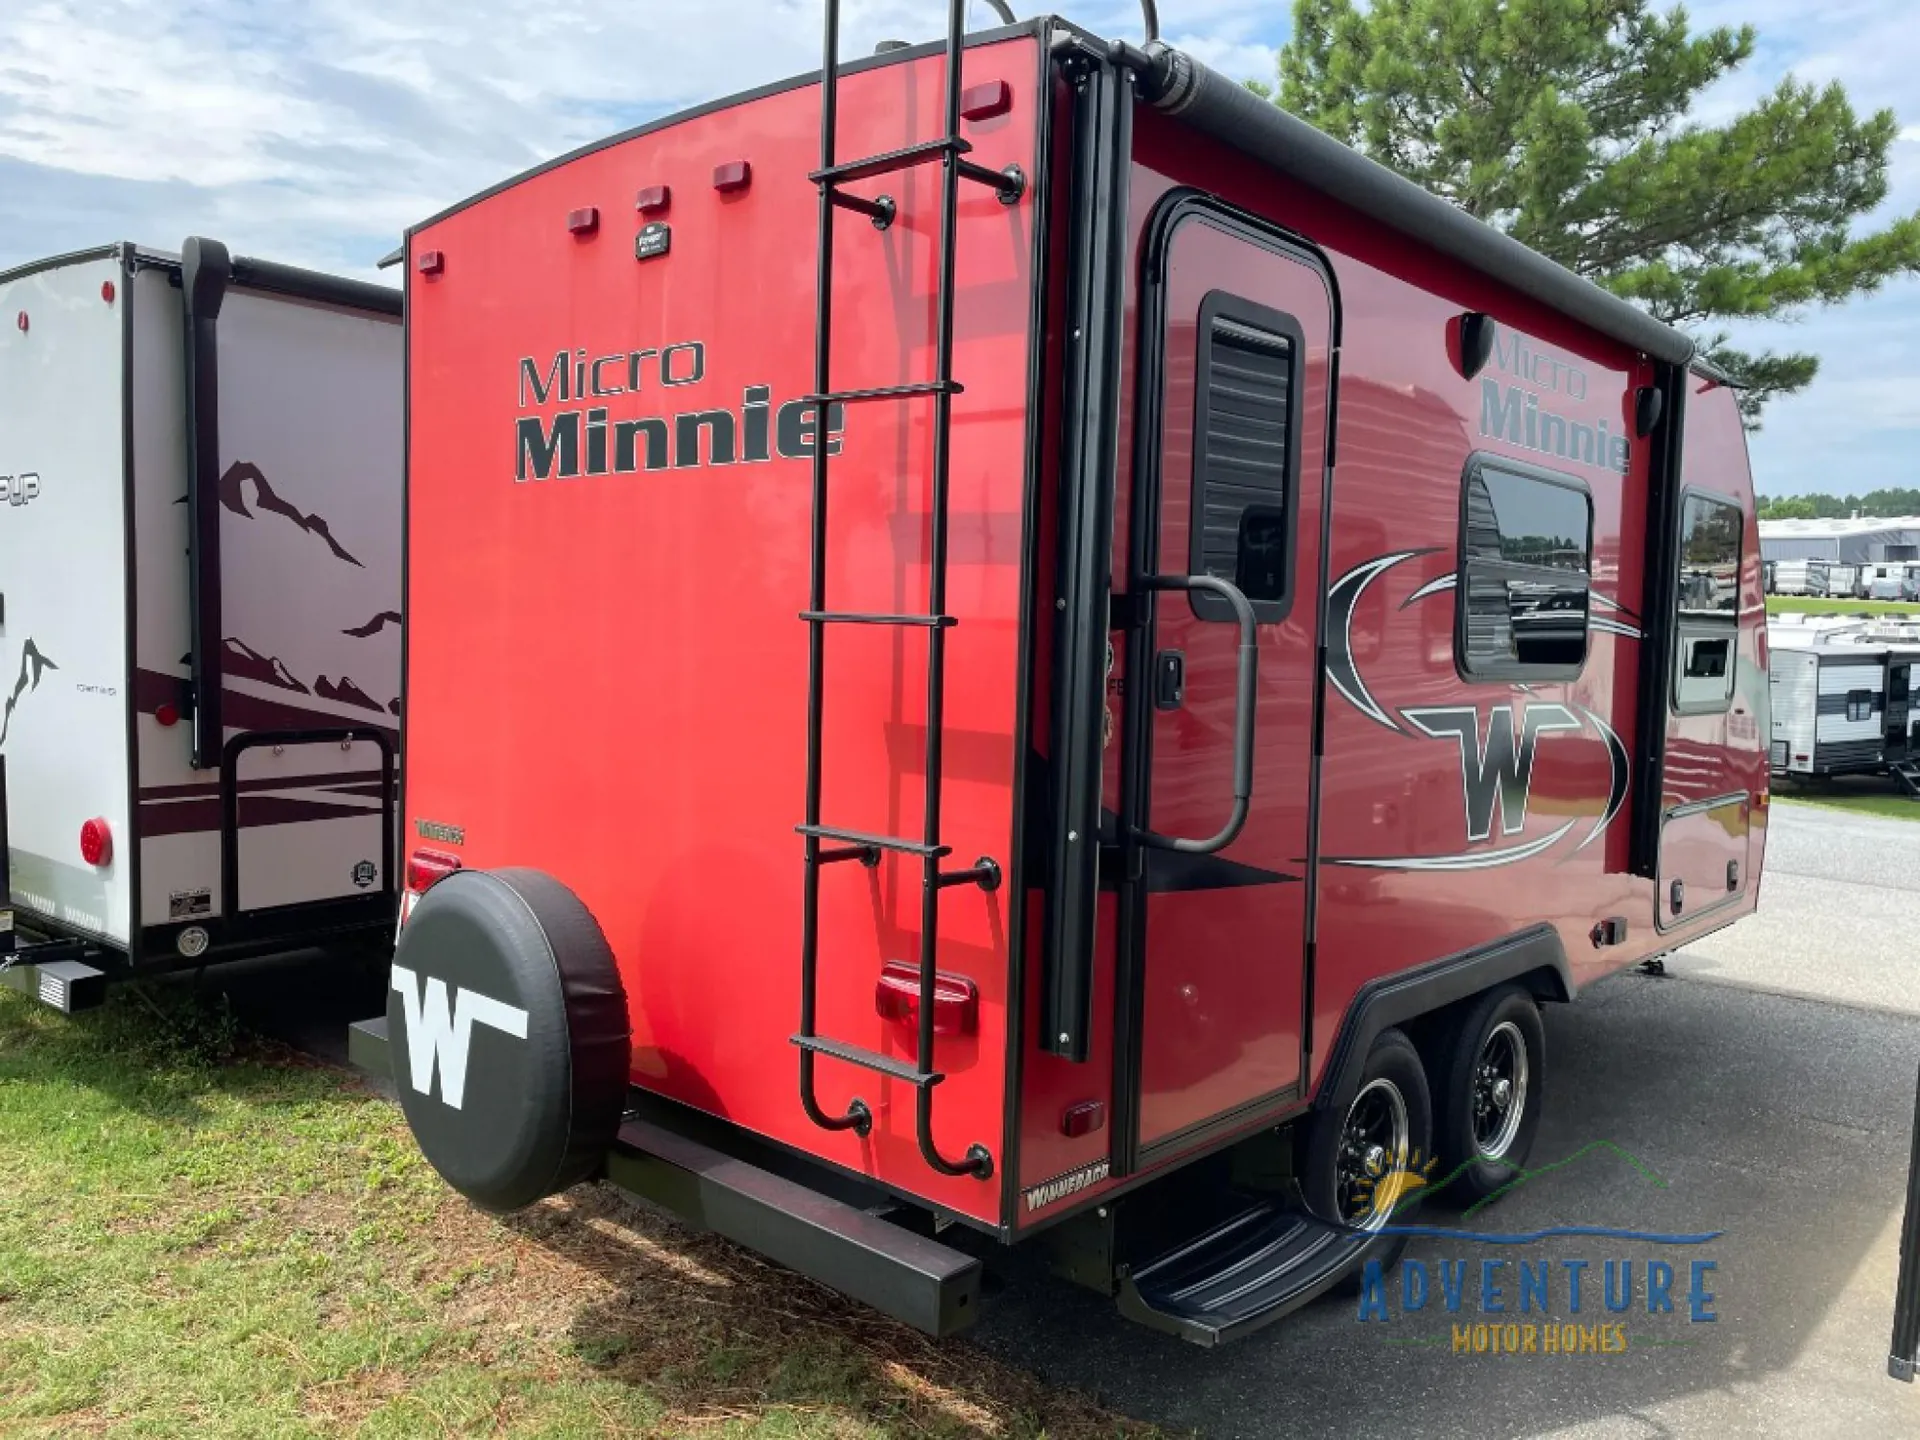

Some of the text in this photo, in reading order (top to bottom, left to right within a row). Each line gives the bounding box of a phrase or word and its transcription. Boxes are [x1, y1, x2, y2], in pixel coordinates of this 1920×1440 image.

[518, 340, 705, 408] Micro
[1488, 326, 1588, 401] Micro
[514, 384, 845, 483] Minnie
[1480, 375, 1631, 476] Minnie
